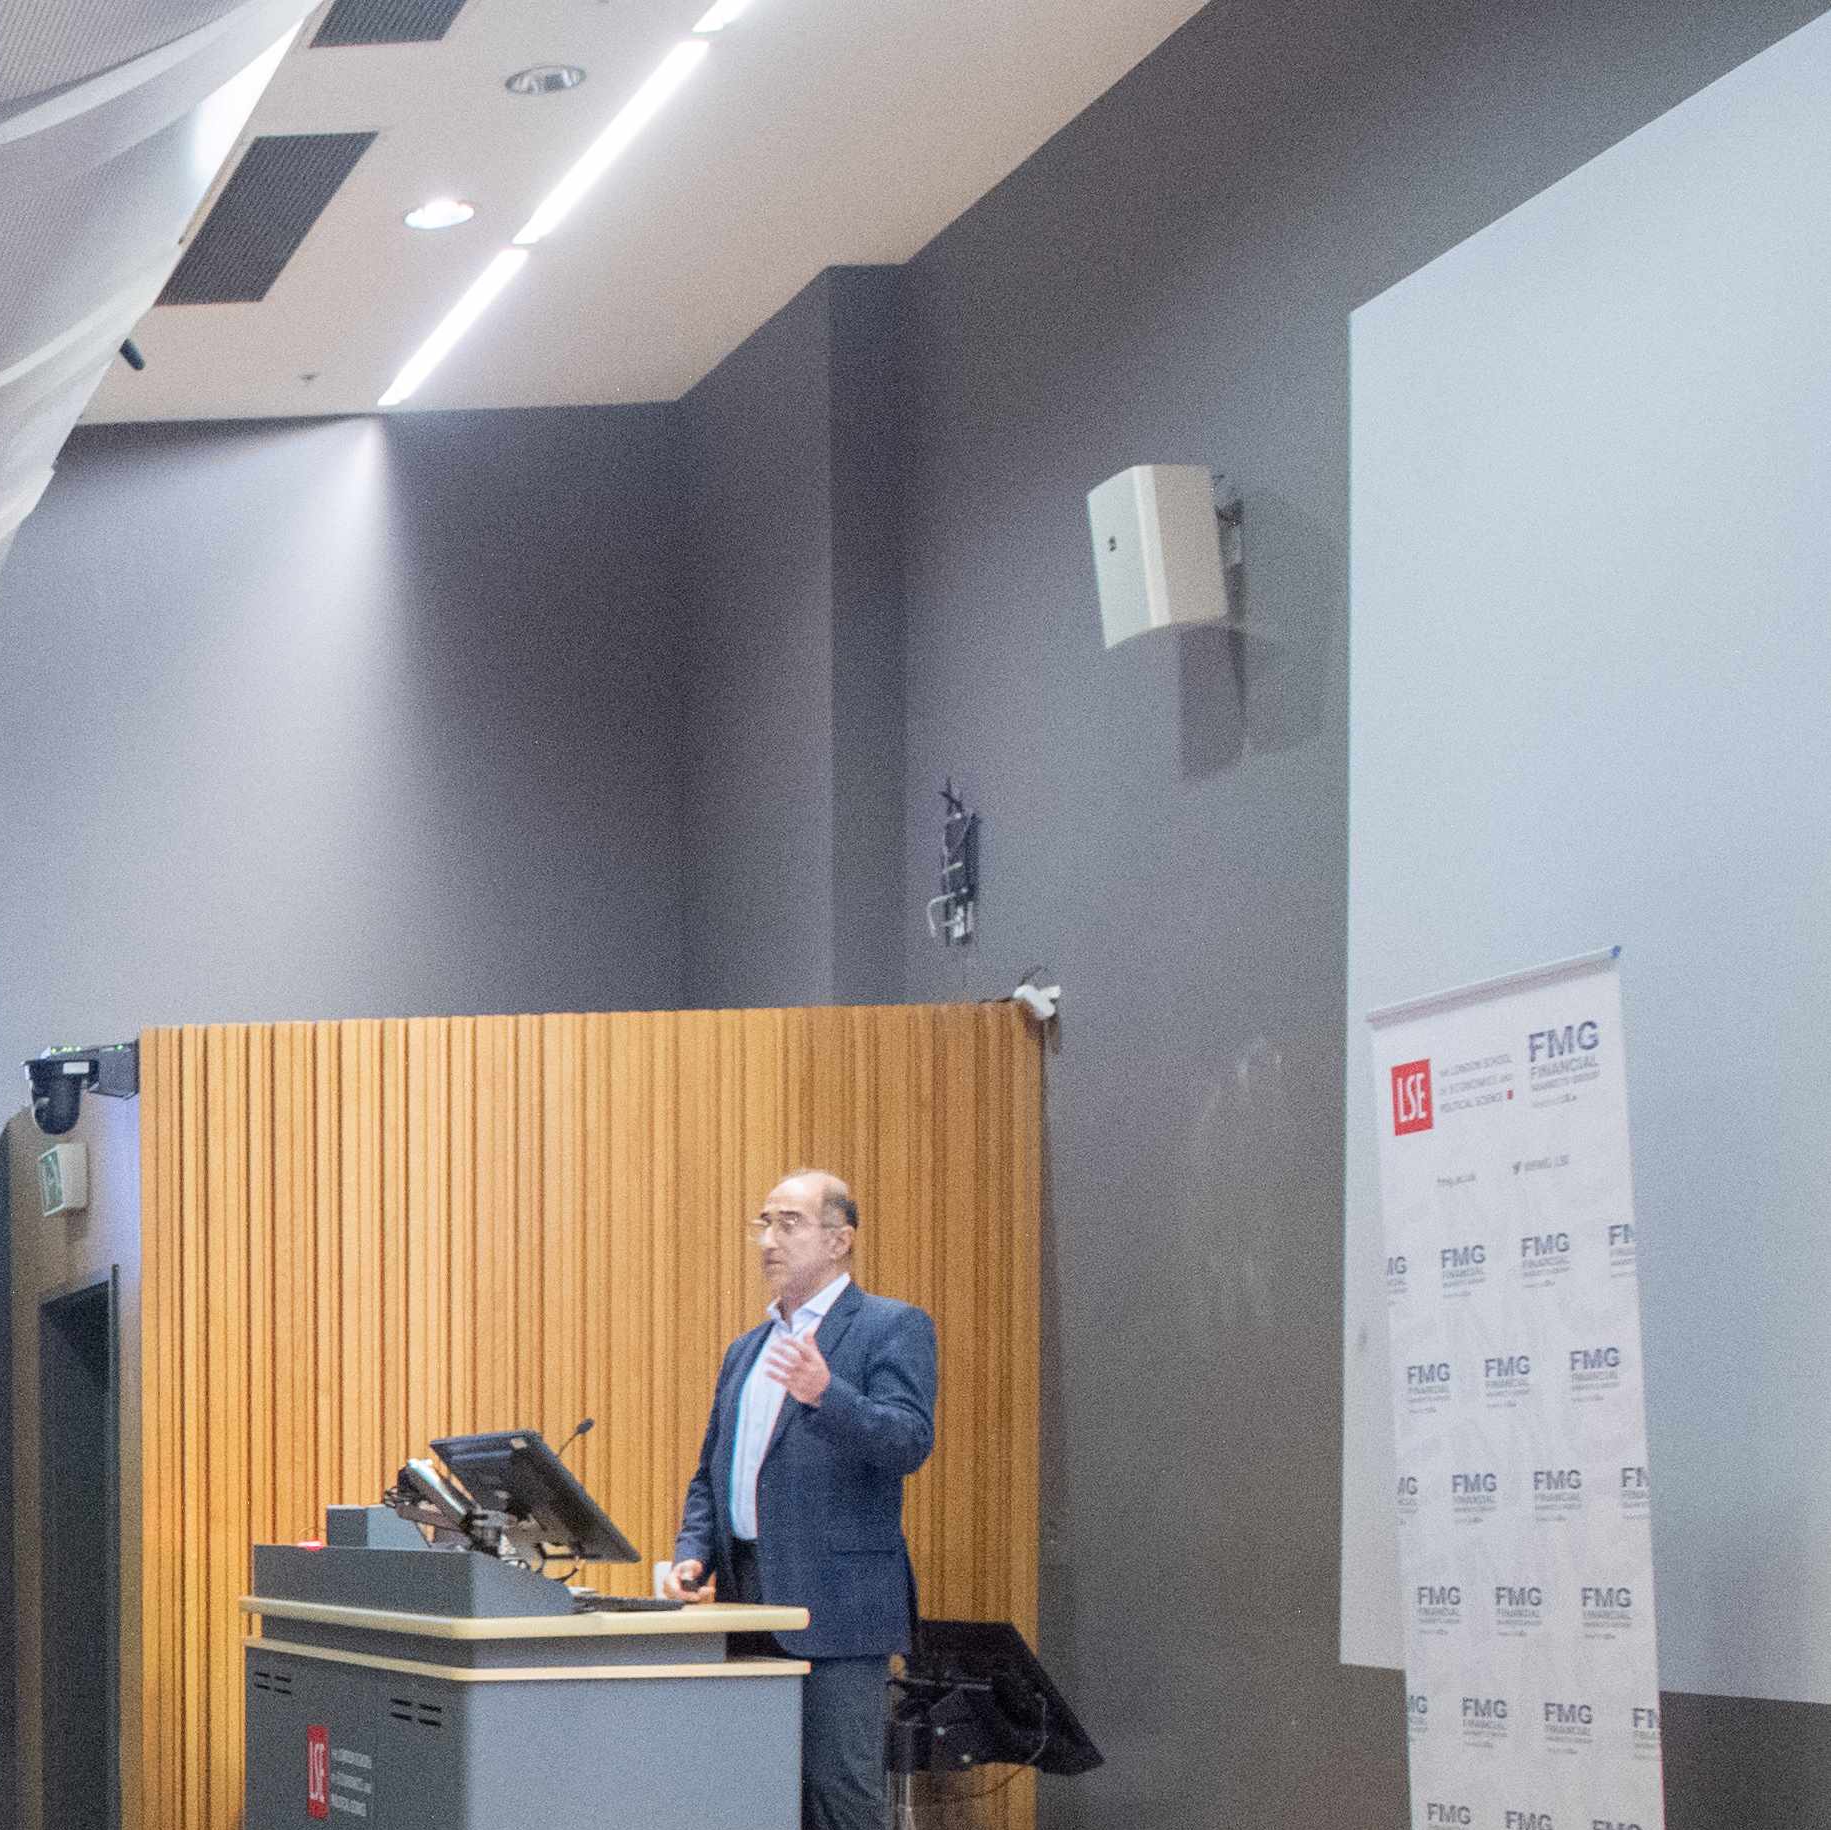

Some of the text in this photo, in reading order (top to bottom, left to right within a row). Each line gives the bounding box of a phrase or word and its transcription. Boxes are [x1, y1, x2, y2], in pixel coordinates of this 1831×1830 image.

[1528, 1021, 1600, 1062] FMG
[1396, 1073, 1427, 1123] LSE
[1521, 1232, 1570, 1257] FMG
[1441, 1245, 1486, 1268] FMG
[1484, 1355, 1531, 1378] FMG
[1570, 1347, 1620, 1370] FMG
[1407, 1363, 1451, 1385] FMG
[1452, 1473, 1497, 1493] FMG
[1533, 1470, 1582, 1491] FMG
[1417, 1586, 1461, 1606] FMG
[1495, 1586, 1542, 1607] FMG
[1581, 1587, 1632, 1608] FMG
[1462, 1697, 1508, 1719] FMG
[1544, 1702, 1593, 1725] FMG
[1427, 1802, 1472, 1825] FMG
